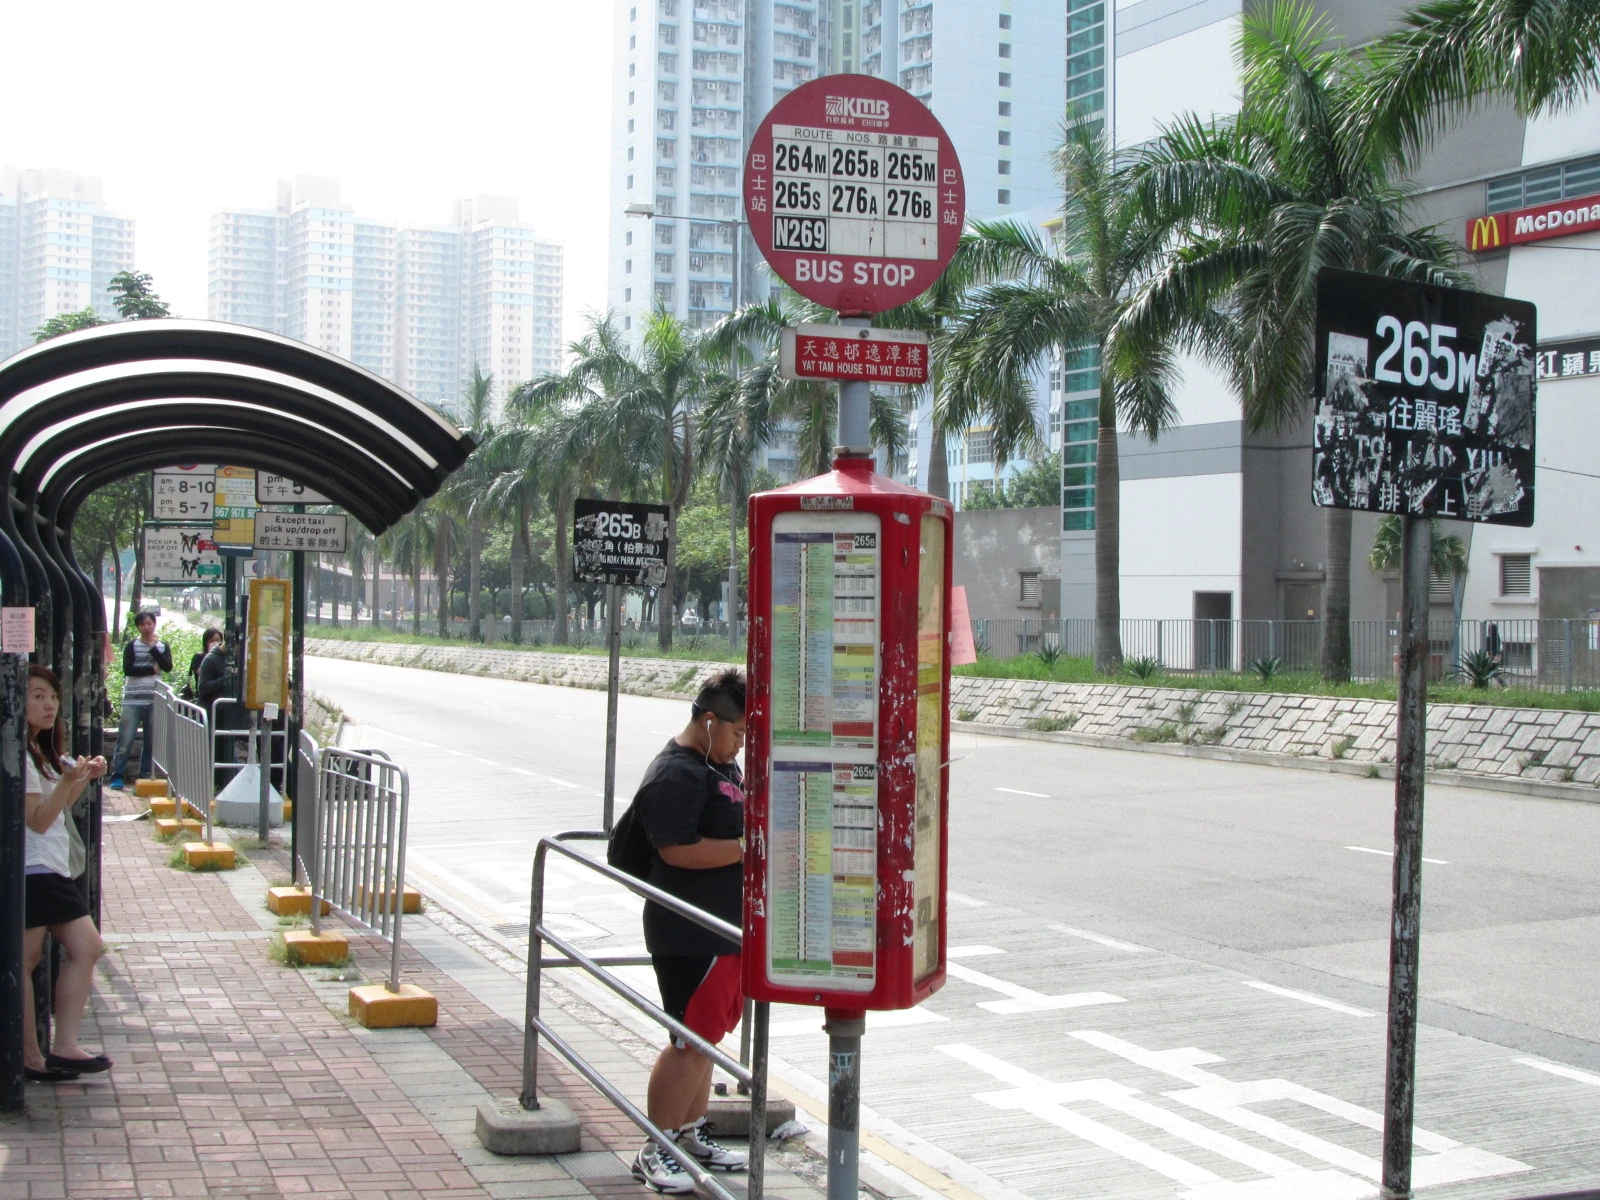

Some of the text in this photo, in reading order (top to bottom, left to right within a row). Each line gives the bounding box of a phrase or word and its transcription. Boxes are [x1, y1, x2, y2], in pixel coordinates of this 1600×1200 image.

[794, 128, 919, 148] ROUTE NOS. 路線號
[775, 143, 936, 182] 264M 265B 265M
[751, 153, 767, 213] 巴士站
[775, 180, 932, 218] 265S 276A 276B
[943, 168, 958, 225] 巴士站
[775, 217, 826, 248] N269
[795, 258, 915, 287] BUS STOP
[802, 340, 923, 366] 天逸邨逸潭樓
[1374, 315, 1477, 394] 265M
[802, 360, 922, 378] YAT TAM HOUSE TIN YAT ESTATE
[1388, 396, 1465, 437] 往麗瑤
[267, 475, 284, 485] pm
[157, 484, 176, 495] 上午
[263, 485, 288, 497] 下午
[157, 506, 177, 515] 下午
[160, 498, 173, 507] pm
[215, 507, 230, 517] 967
[275, 515, 325, 526] Except taxi
[264, 525, 336, 536] pick up/drop off
[597, 511, 642, 540] 265B
[259, 536, 340, 548] 的士上落客除外
[854, 535, 876, 547] 265B
[853, 765, 875, 778] 265M
